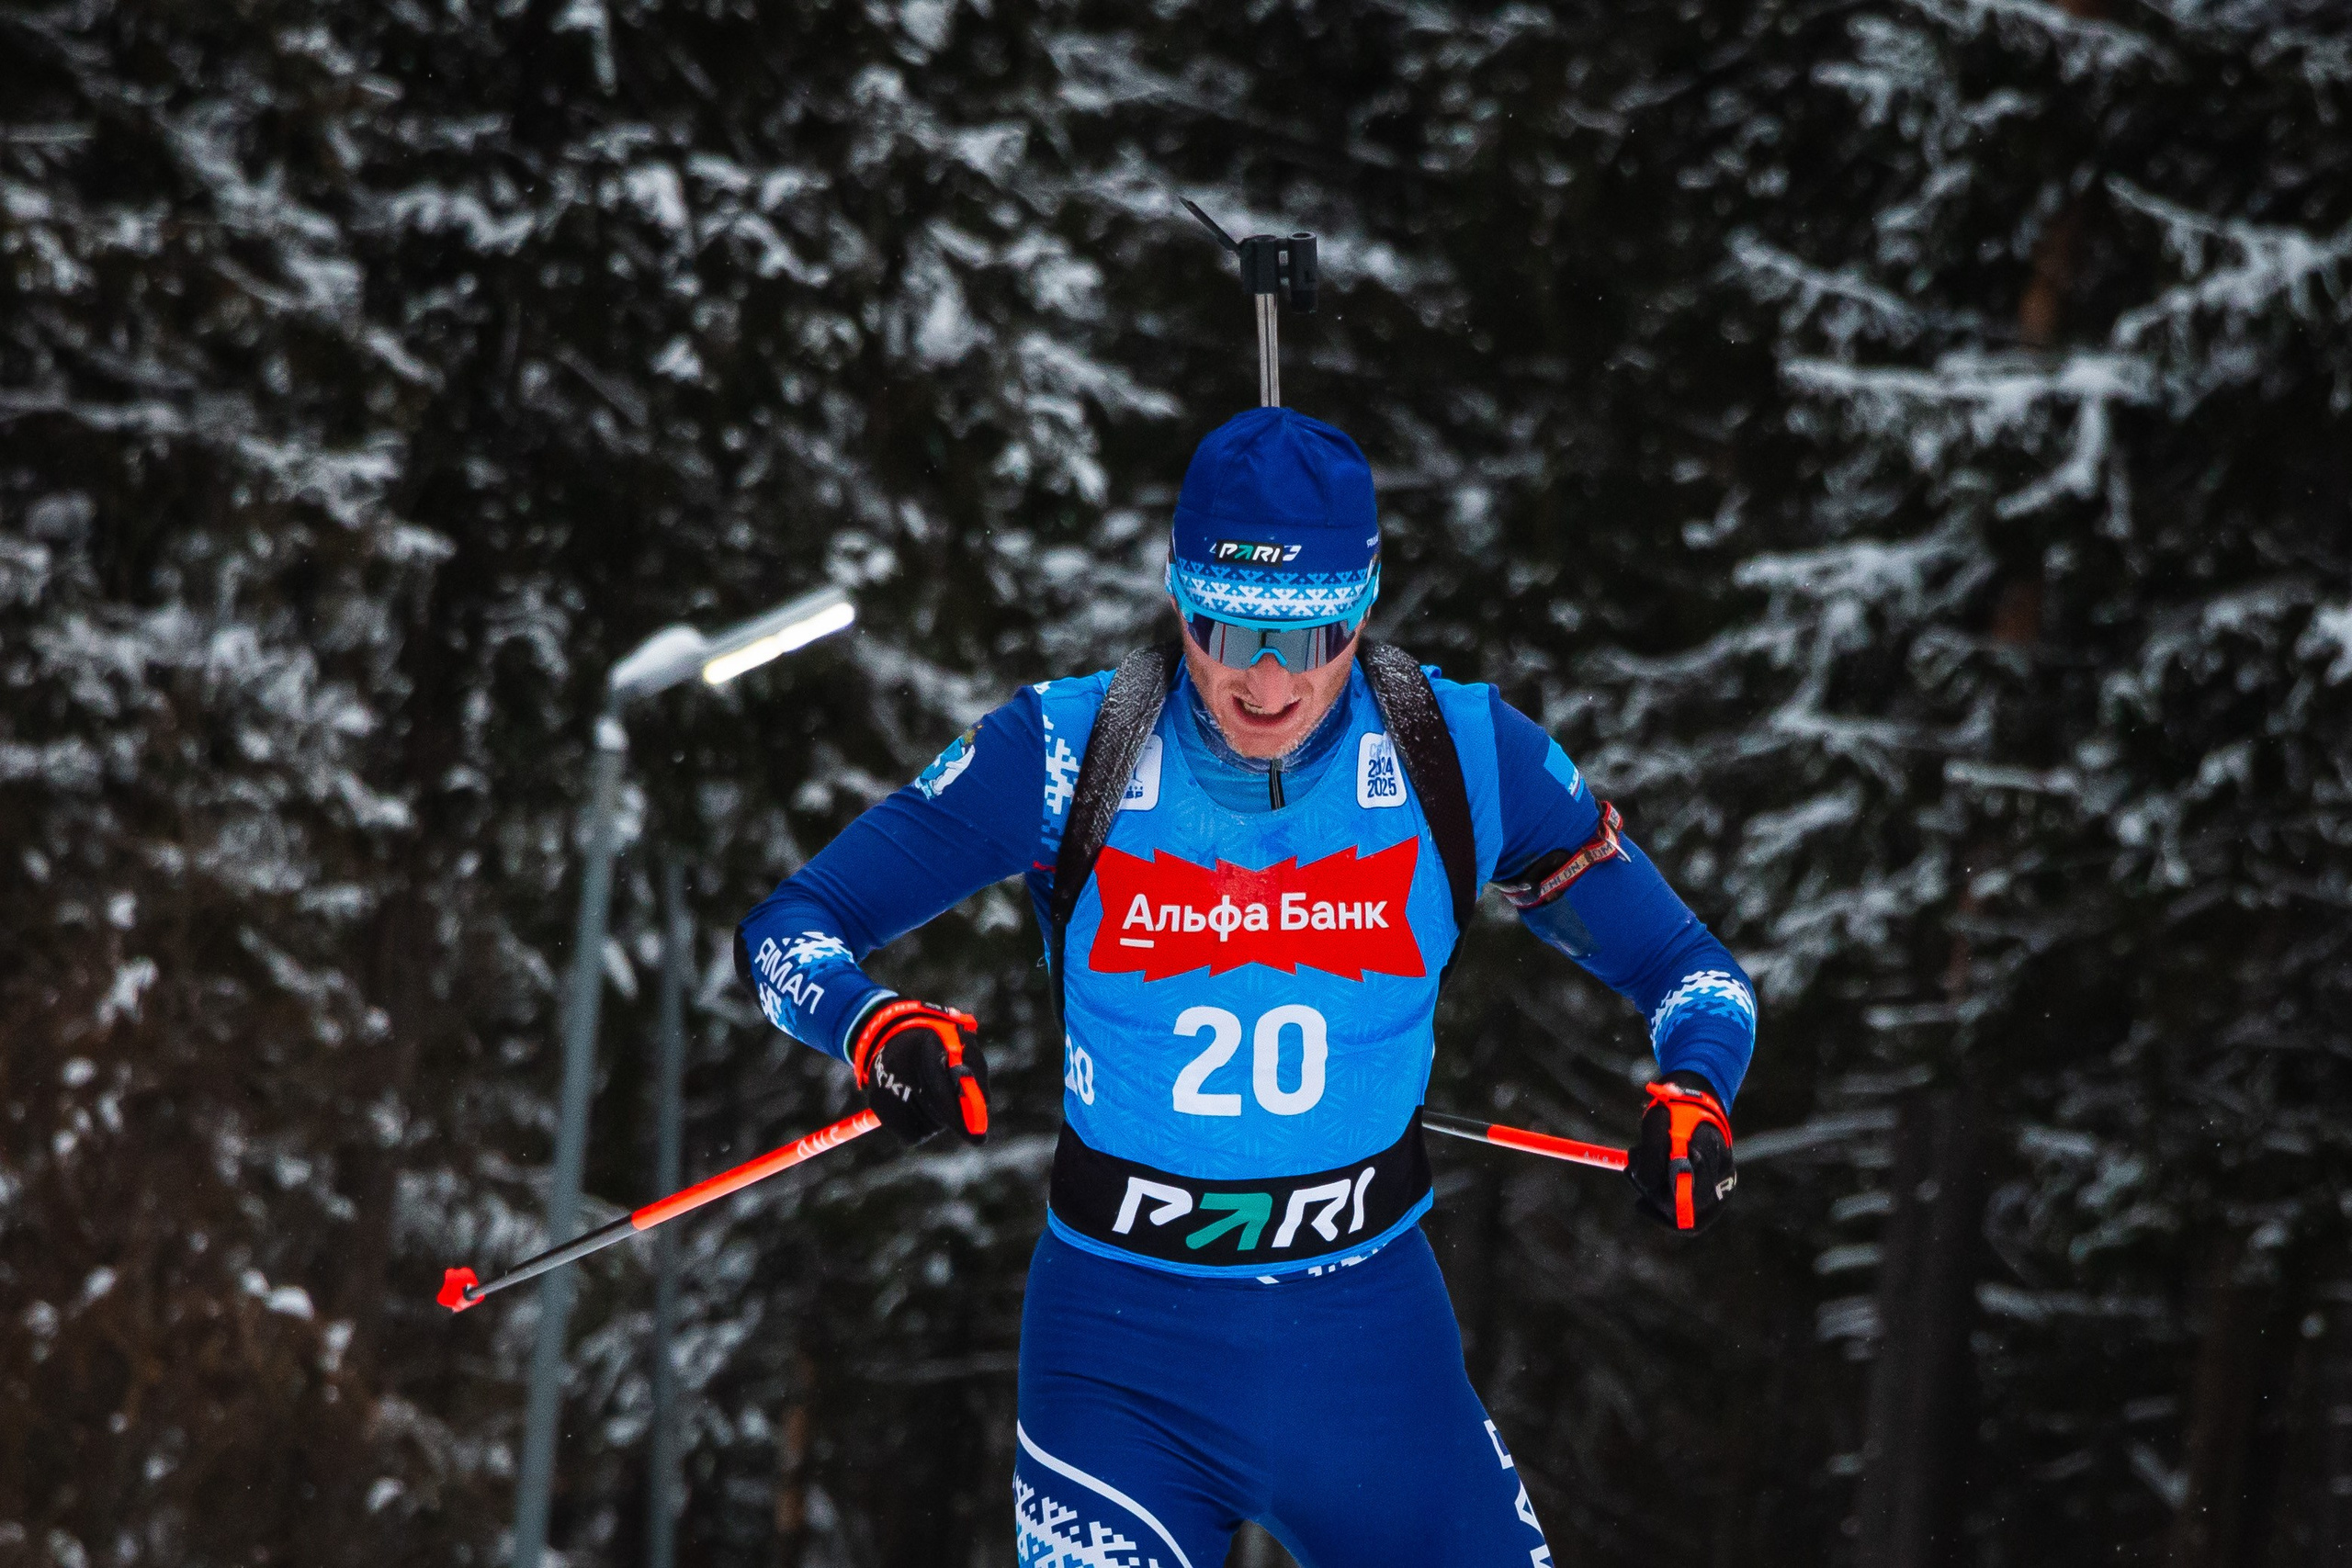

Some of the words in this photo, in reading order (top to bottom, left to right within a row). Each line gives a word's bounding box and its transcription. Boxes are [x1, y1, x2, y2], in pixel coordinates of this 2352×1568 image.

[1218, 543, 1281, 563] PARI
[1366, 776, 1397, 798] 2025
[1120, 893, 1270, 947] Альфа
[1280, 892, 1390, 931] Банк
[754, 937, 825, 1015] ЯМАЛ
[1172, 1004, 1329, 1117] 20
[1112, 1167, 1375, 1251] PARI
